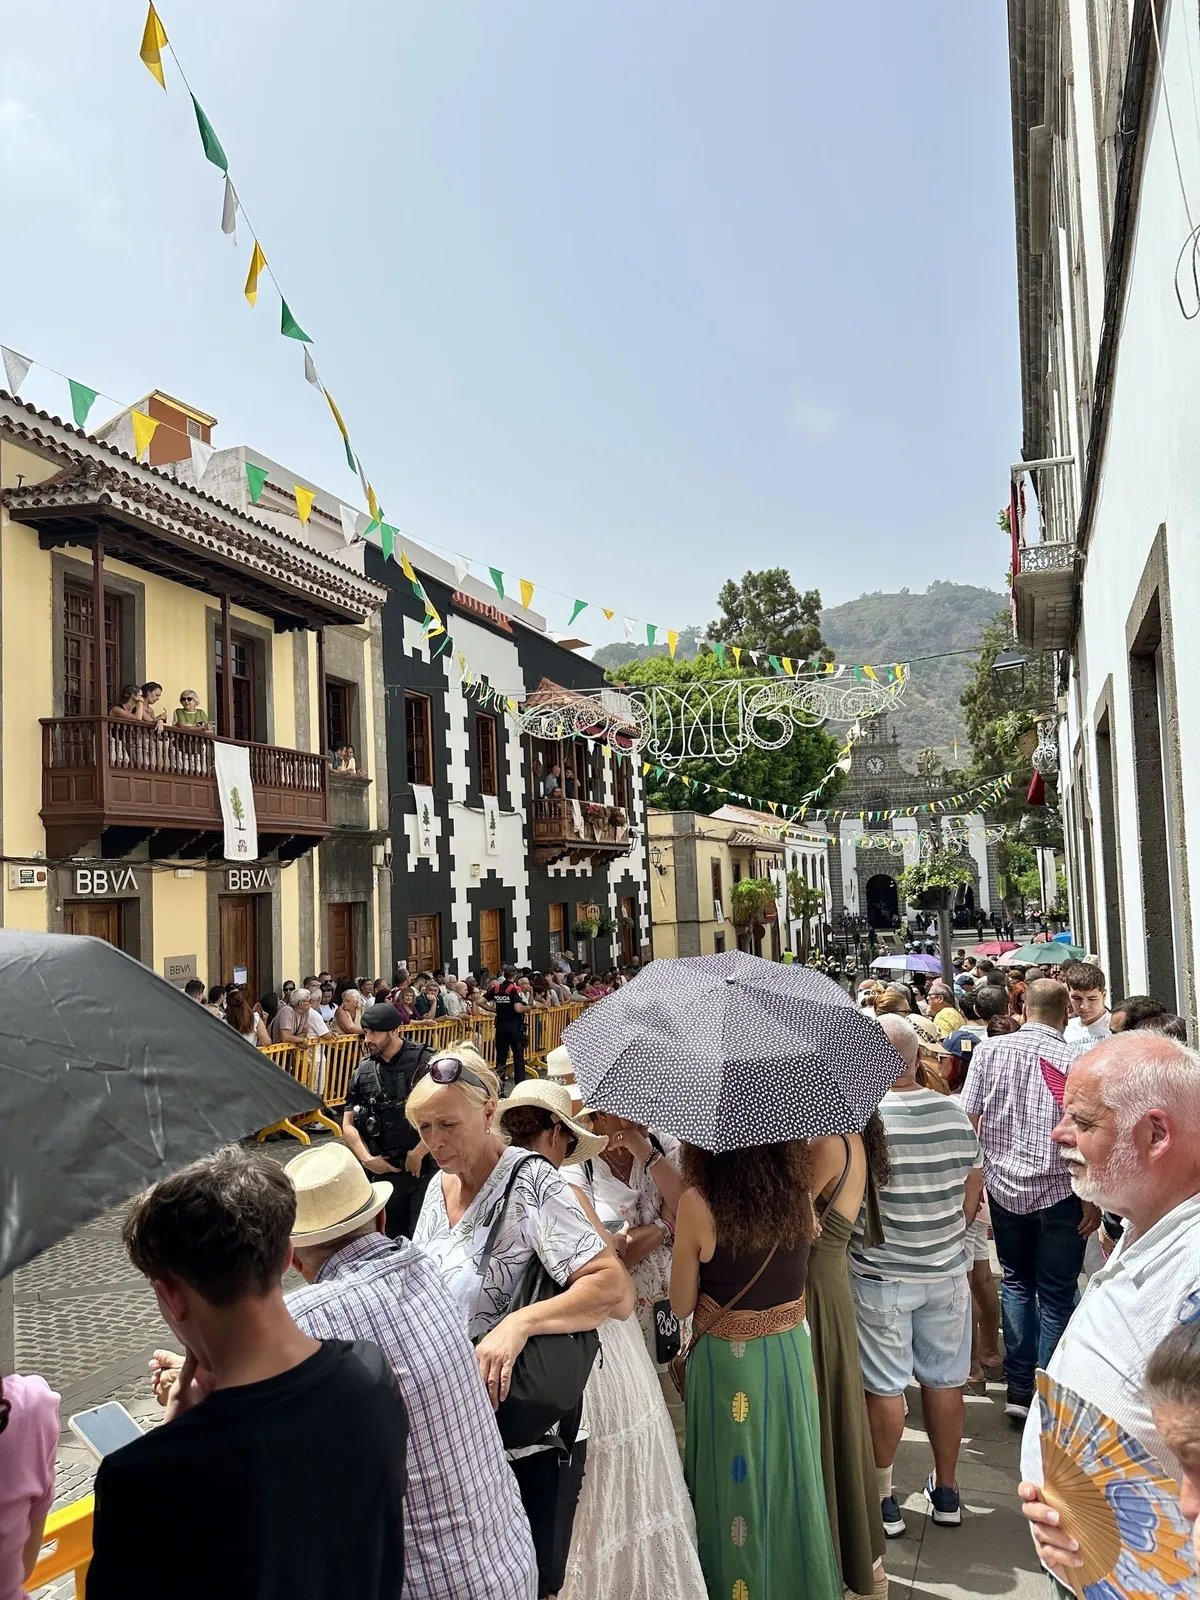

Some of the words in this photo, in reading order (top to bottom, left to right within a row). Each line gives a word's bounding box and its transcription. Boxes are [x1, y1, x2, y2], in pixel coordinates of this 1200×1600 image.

[76, 867, 138, 894] BBVA
[229, 867, 272, 890] BBVA
[169, 963, 191, 976] BBVA
